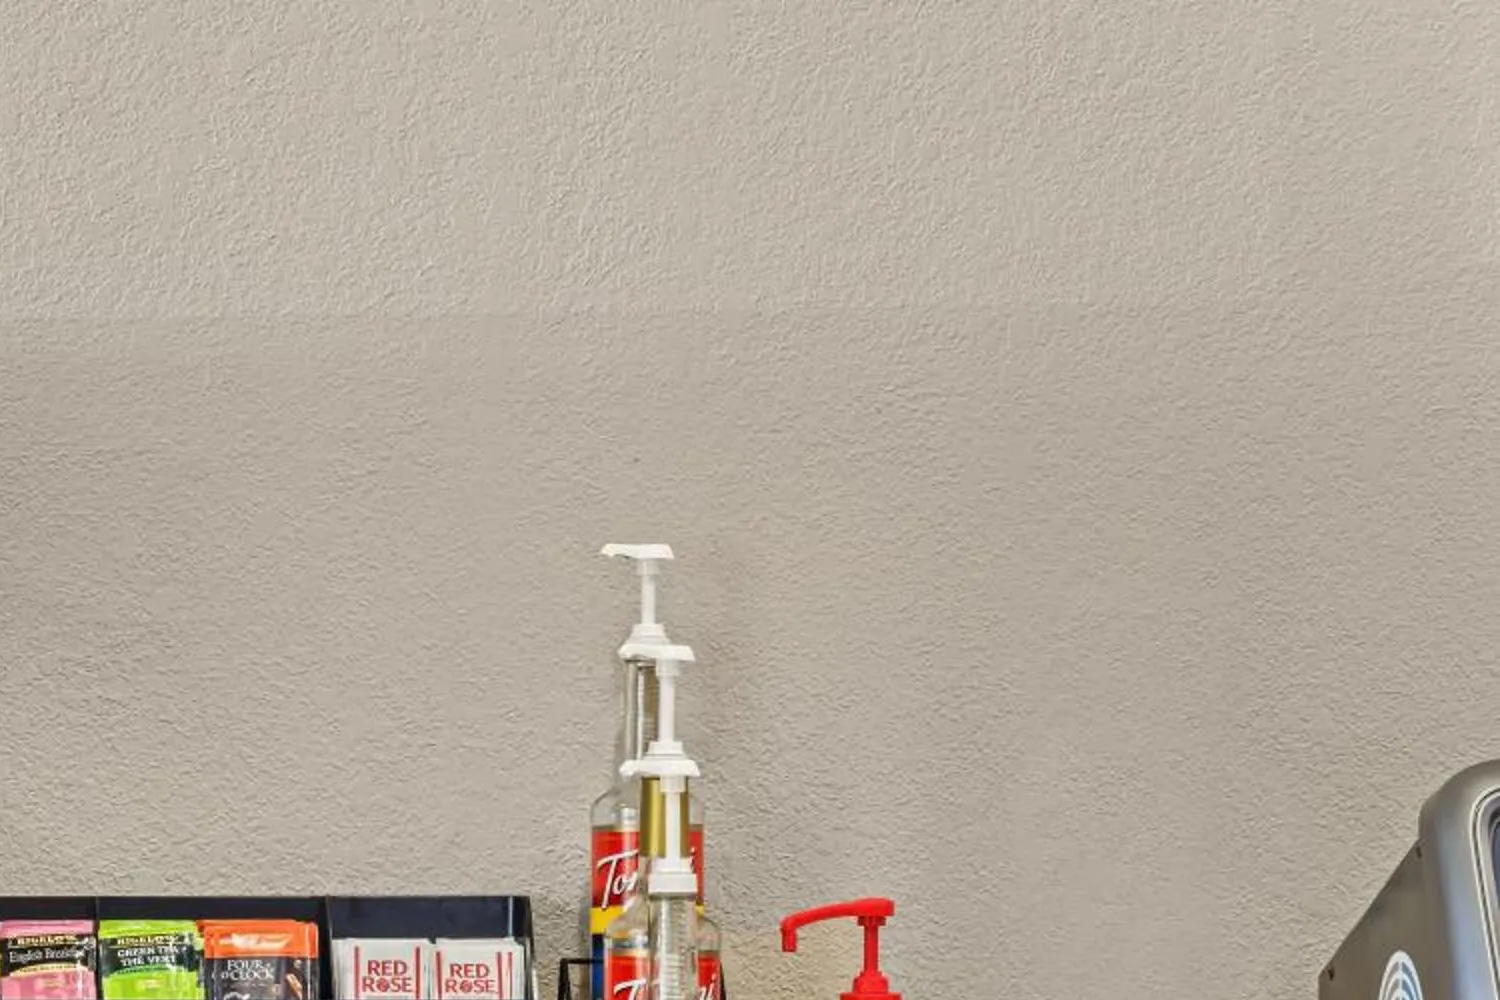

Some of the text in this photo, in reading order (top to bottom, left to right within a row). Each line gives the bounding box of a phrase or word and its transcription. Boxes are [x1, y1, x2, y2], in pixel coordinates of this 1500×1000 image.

[227, 959, 263, 971] FOUR
[367, 959, 408, 976] RED
[450, 963, 489, 978] RED
[361, 977, 413, 993] ROSE
[445, 979, 496, 994] ROSE
